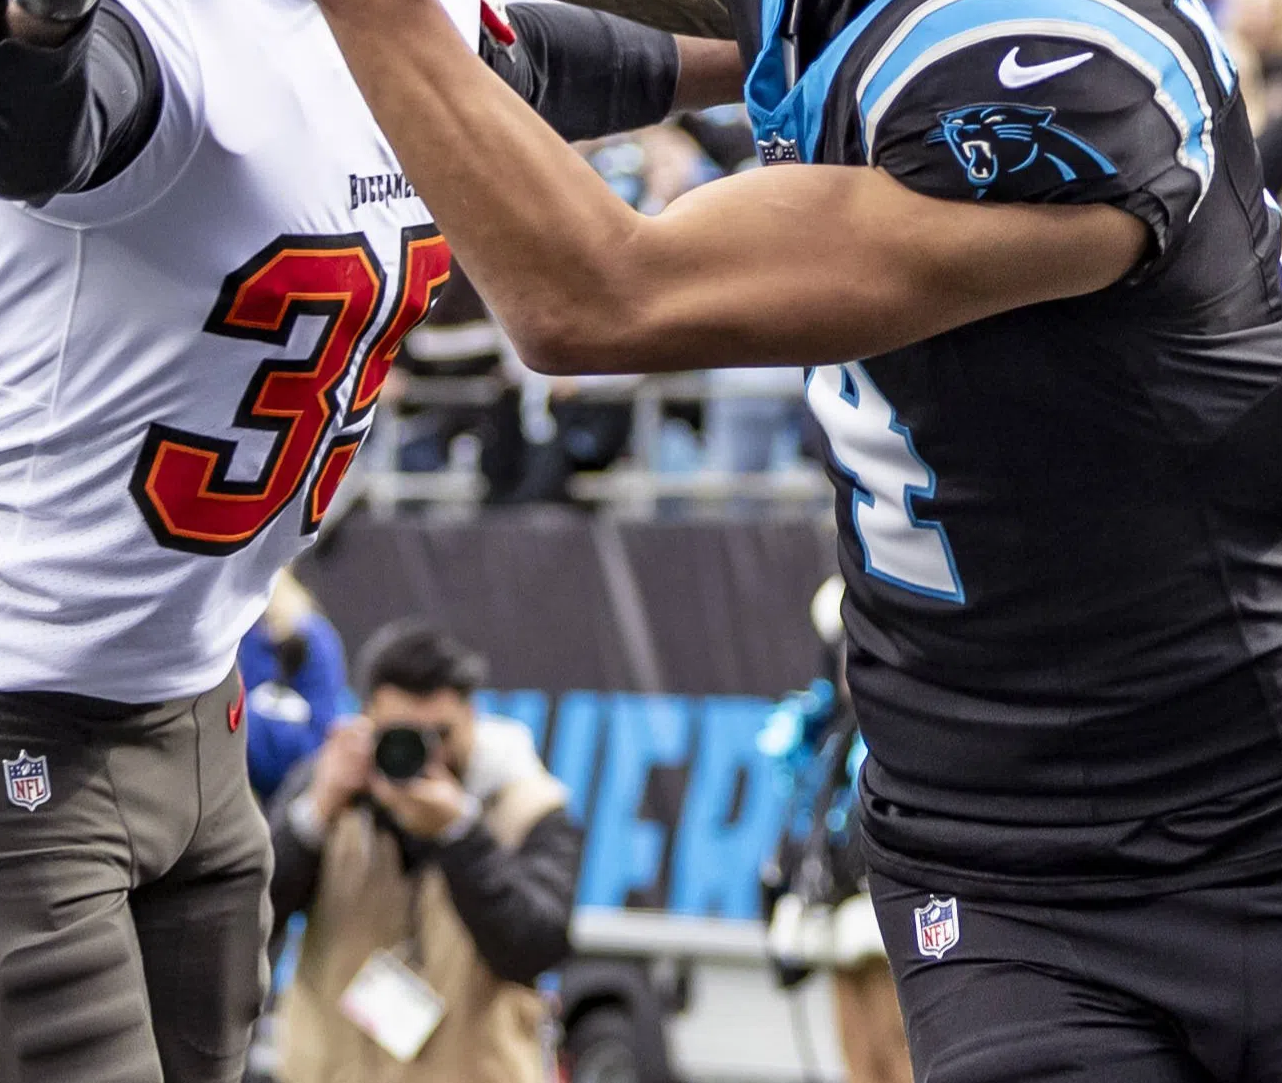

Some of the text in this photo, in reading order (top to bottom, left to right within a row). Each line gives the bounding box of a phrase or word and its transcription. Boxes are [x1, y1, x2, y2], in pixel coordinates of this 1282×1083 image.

[805, 362, 966, 604] 4
[14, 778, 44, 800] NFL
[923, 922, 951, 947] NFL
